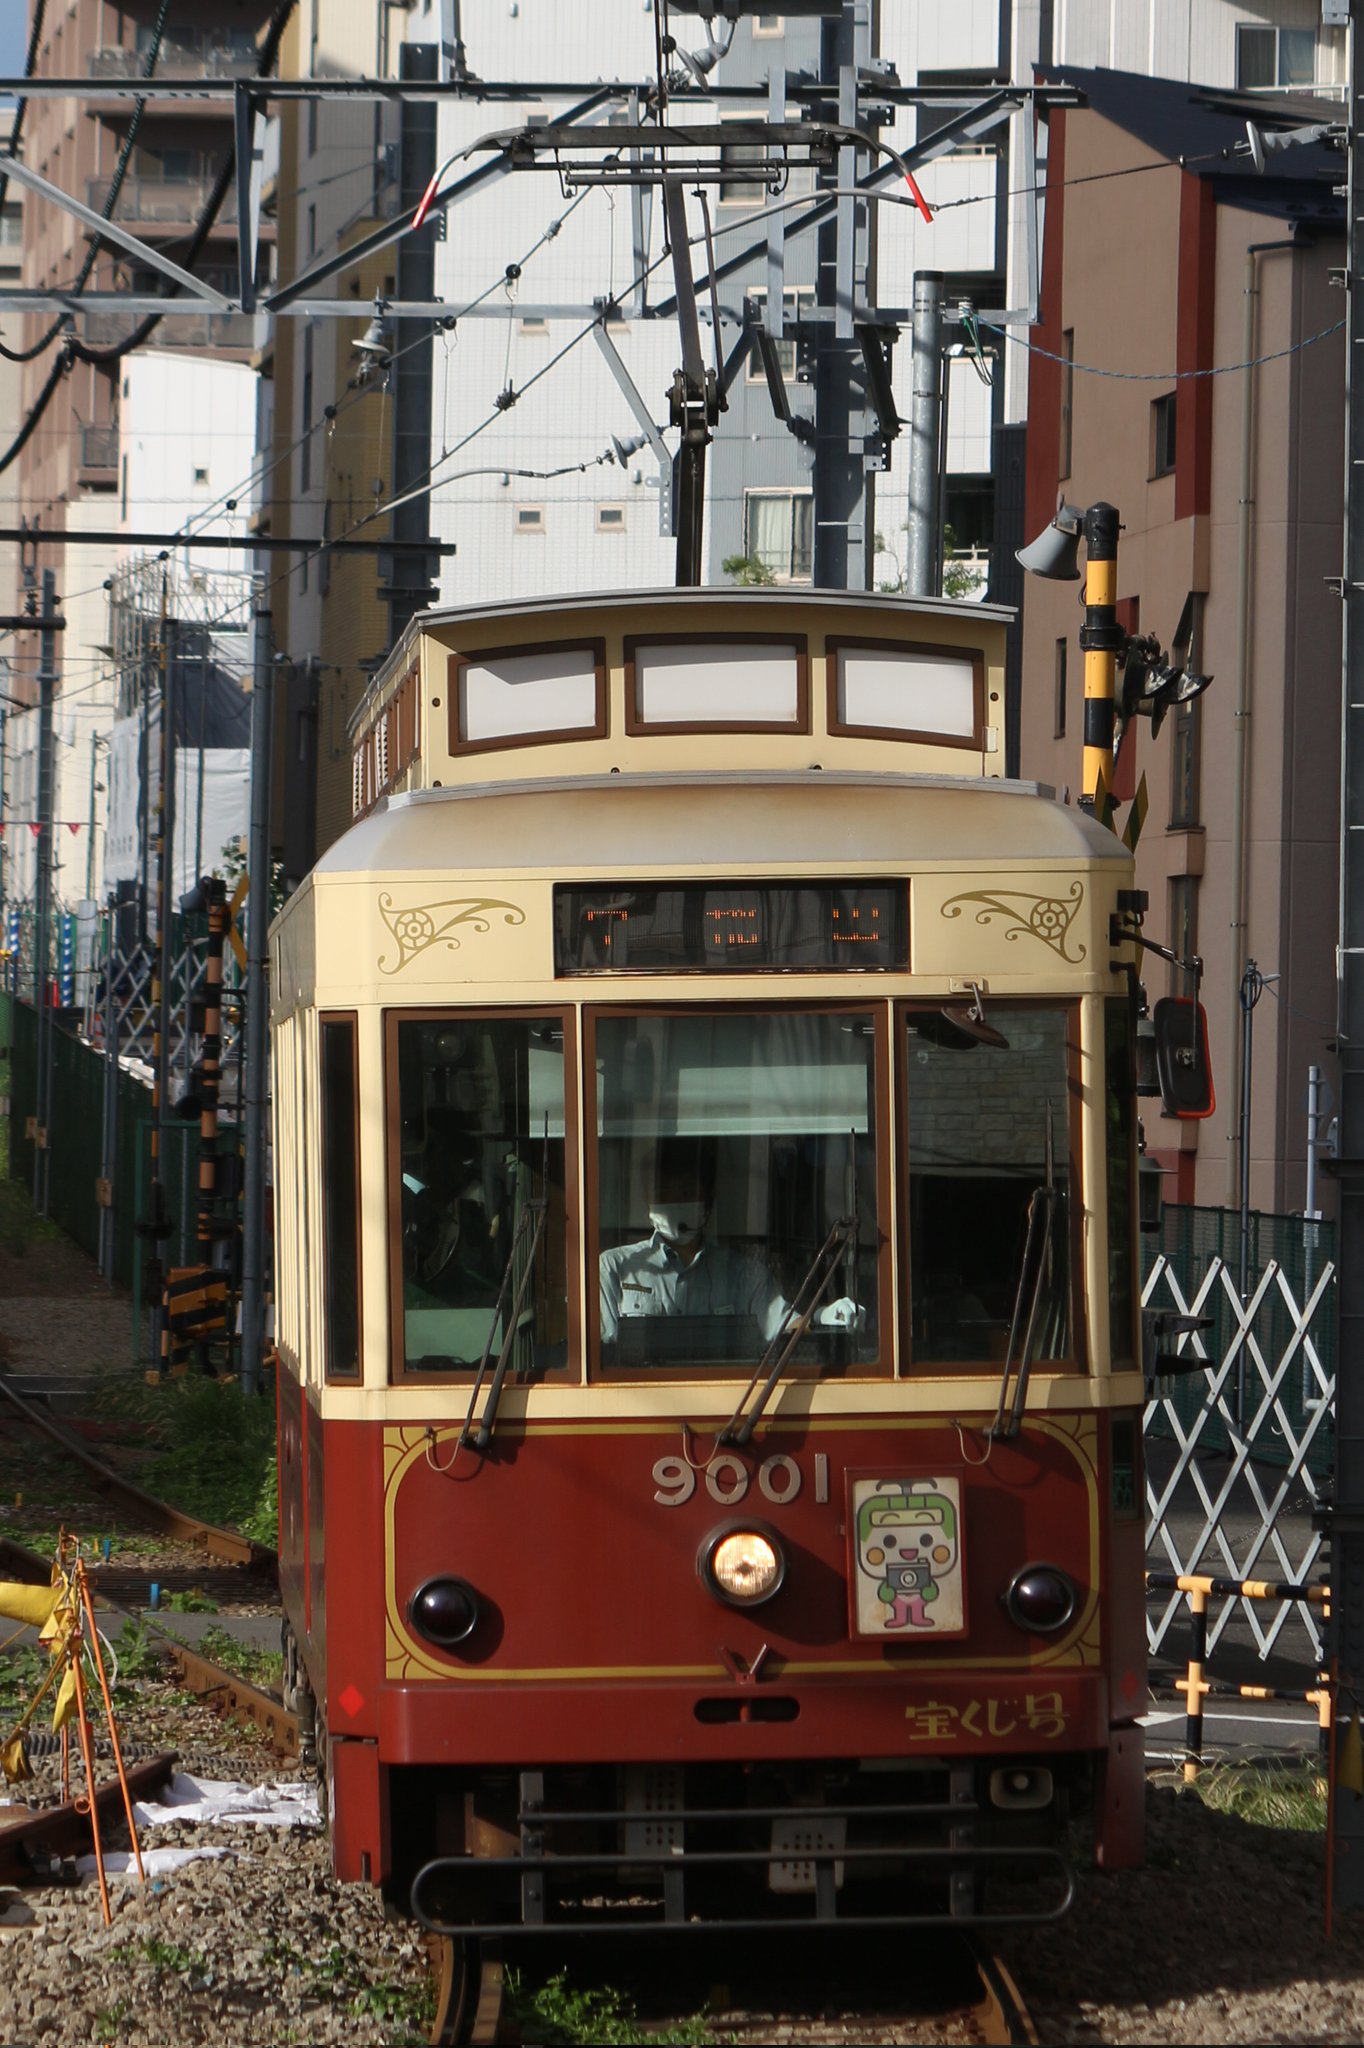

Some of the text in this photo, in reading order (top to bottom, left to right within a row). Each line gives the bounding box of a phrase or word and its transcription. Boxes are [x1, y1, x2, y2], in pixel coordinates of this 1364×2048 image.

[652, 1453, 828, 1506] 9001
[905, 1692, 1071, 1740] 宝くじ号
